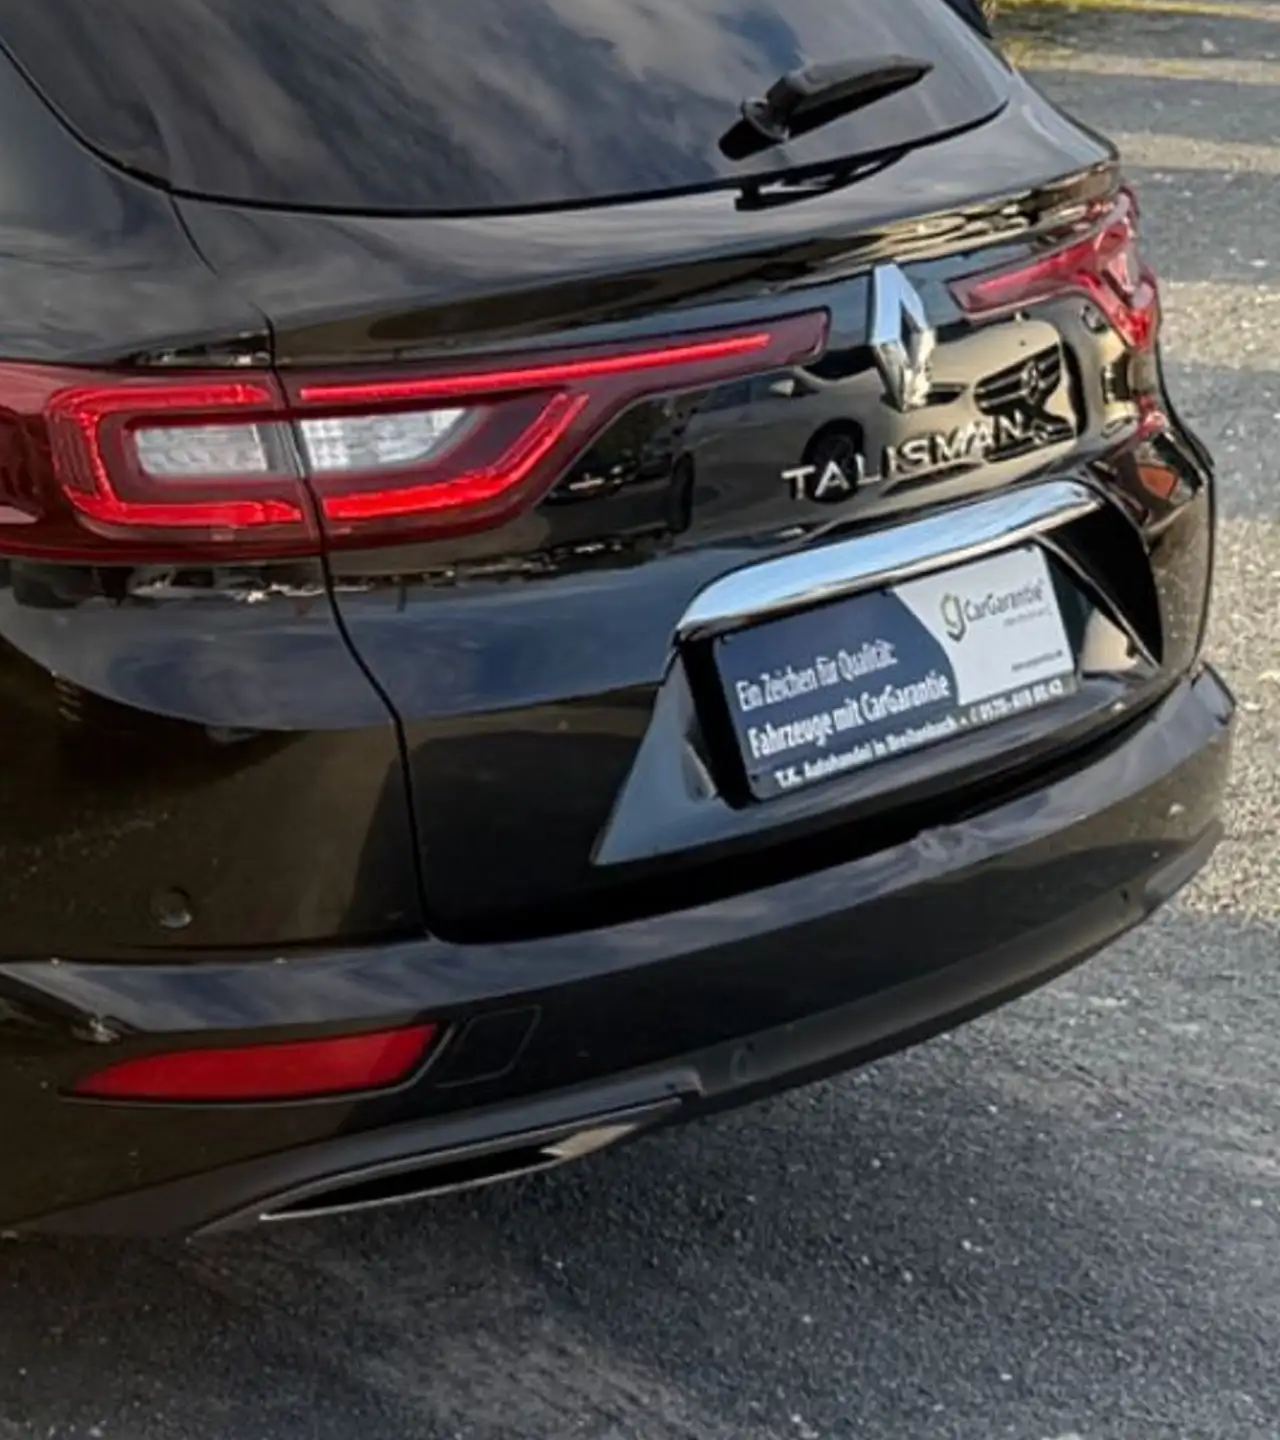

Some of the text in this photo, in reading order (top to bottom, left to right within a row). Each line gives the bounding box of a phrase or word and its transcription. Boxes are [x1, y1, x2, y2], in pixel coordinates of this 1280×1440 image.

[780, 408, 1024, 501] TALISMAN
[736, 679, 764, 712] Ein
[759, 664, 819, 705] Zeichen
[815, 656, 840, 687] für
[747, 711, 834, 760] Fahrzeuge
[832, 696, 865, 732] mit
[860, 668, 952, 723] CarGarantie
